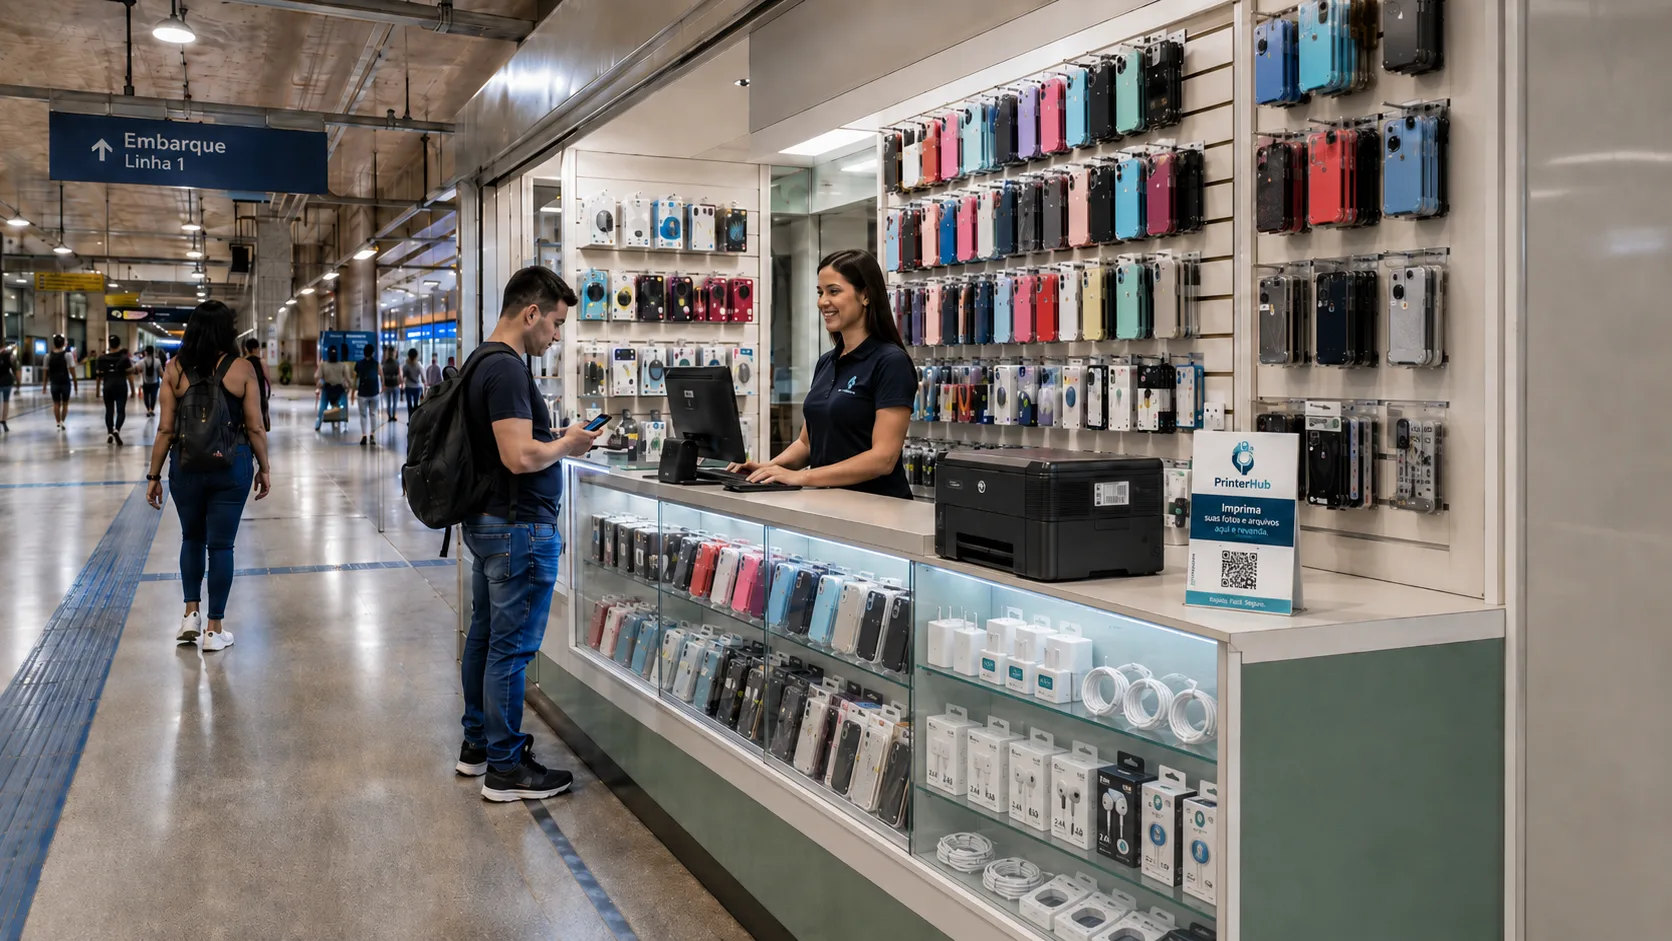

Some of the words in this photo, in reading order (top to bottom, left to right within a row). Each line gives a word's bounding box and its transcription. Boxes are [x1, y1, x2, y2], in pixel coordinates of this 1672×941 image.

[124, 132, 226, 157] Embarque
[125, 154, 171, 170] Linha
[177, 157, 184, 171] 1
[1214, 477, 1271, 489] PrinterHub
[1221, 503, 1262, 515] Imprima
[1248, 518, 1280, 527] arquivos
